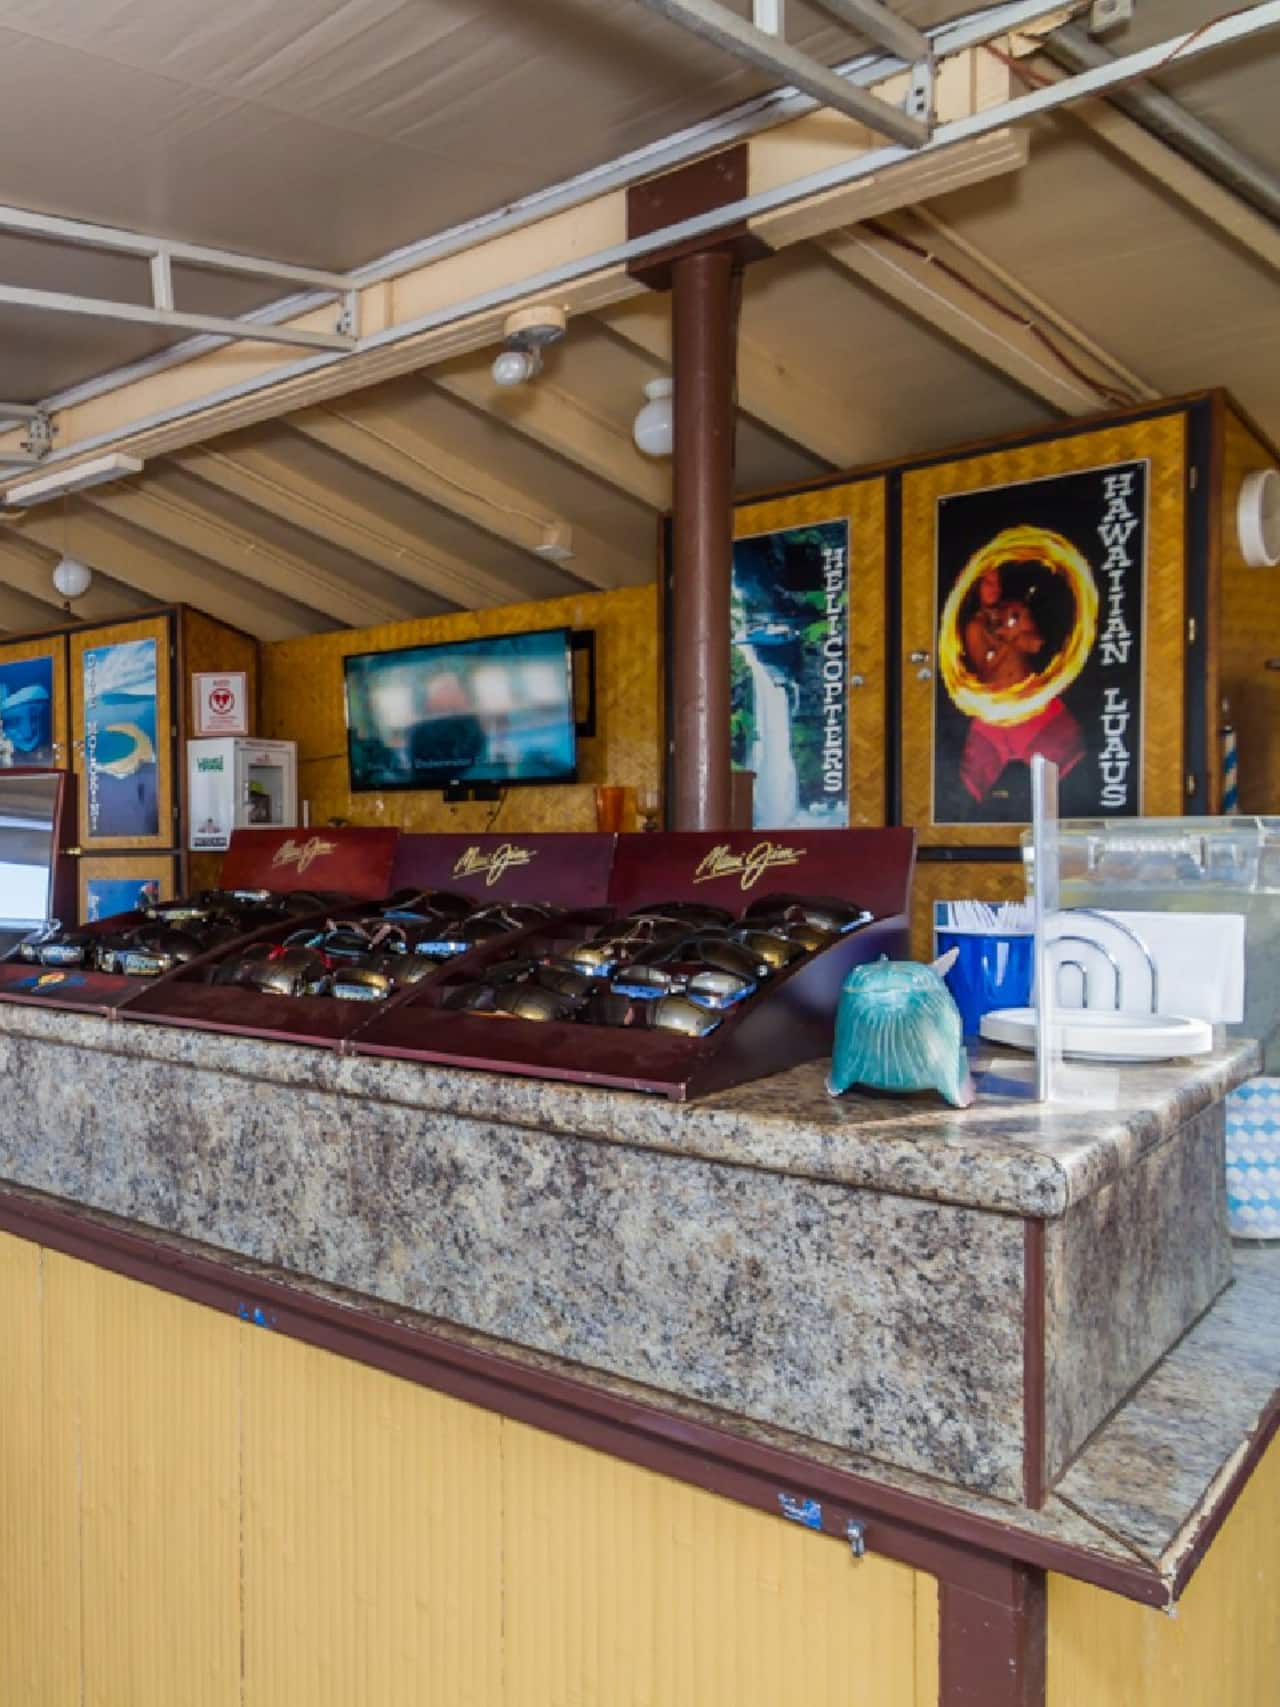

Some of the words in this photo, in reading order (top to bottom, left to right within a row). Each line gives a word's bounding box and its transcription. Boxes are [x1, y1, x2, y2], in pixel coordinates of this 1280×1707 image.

[1098, 473, 1138, 666] HAWAIIAN
[822, 548, 844, 792] HELICOPTERS
[1099, 688, 1131, 808] LUAUS
[453, 847, 491, 879] Maui
[486, 843, 537, 886] Jim
[693, 844, 746, 882] Maui
[740, 841, 808, 890] Jim
